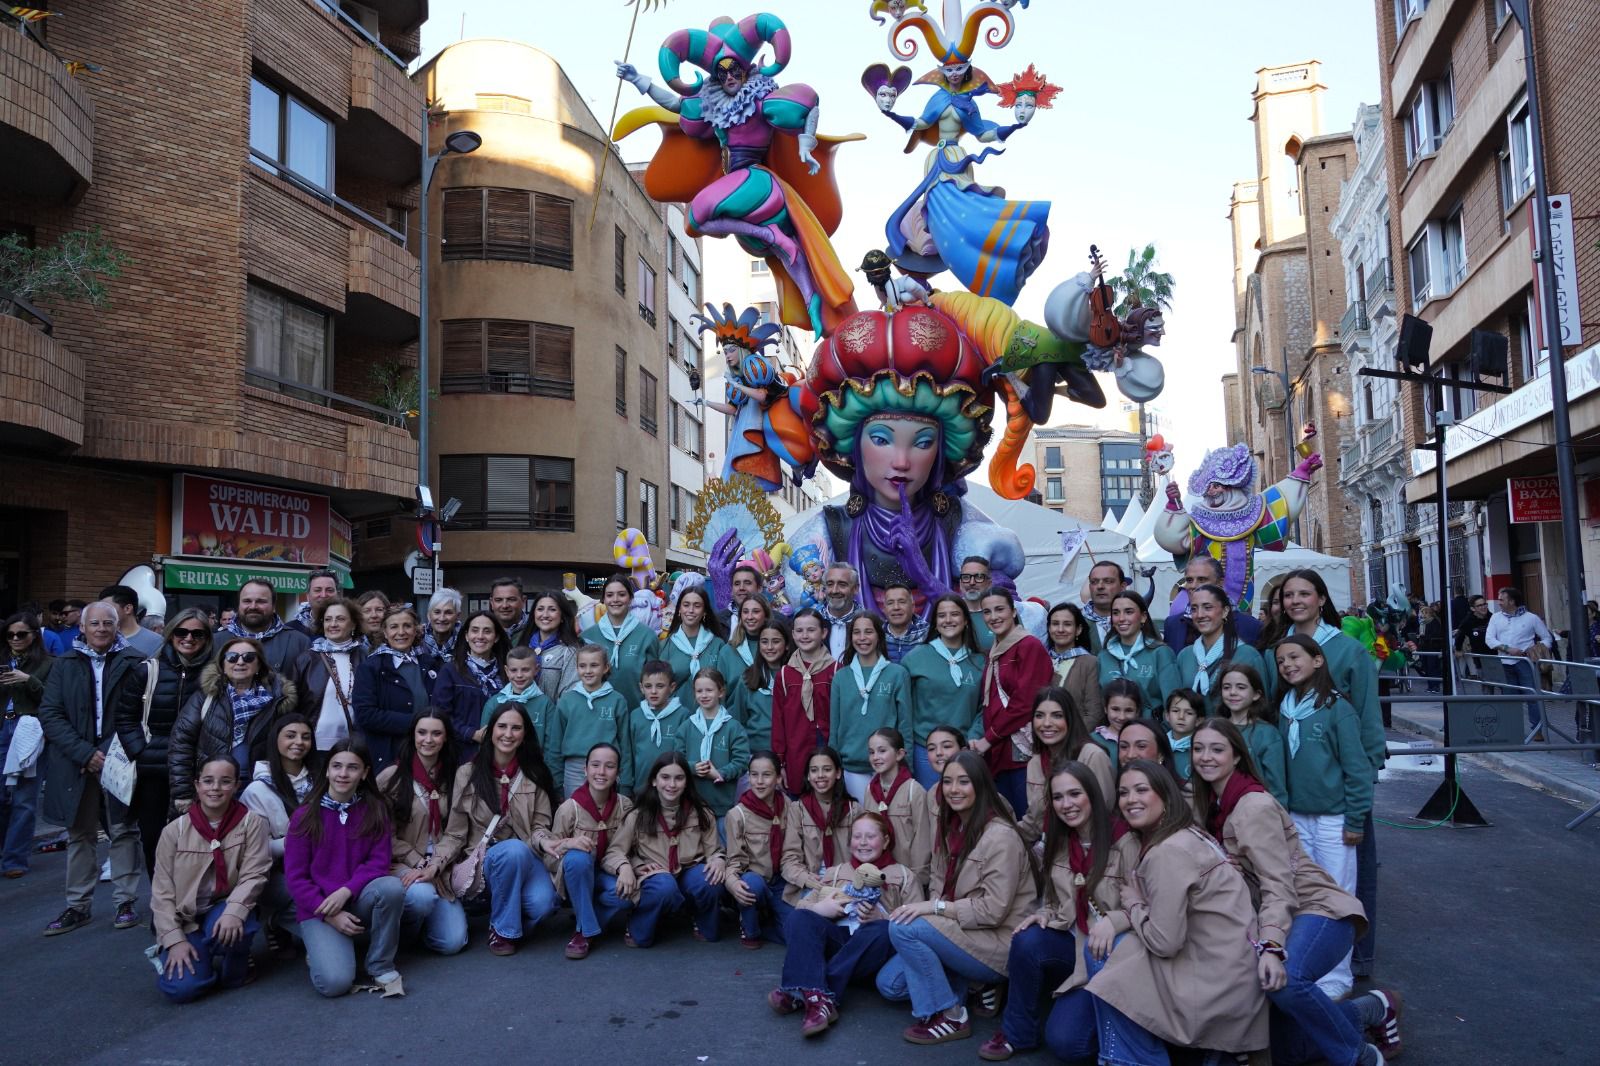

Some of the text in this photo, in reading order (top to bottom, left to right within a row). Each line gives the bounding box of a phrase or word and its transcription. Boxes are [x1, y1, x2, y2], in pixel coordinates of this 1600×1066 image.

[209, 483, 310, 512] SUPERMERCADO
[1520, 489, 1560, 500] BAZA
[209, 502, 311, 539] WALID
[179, 570, 230, 586] FRUTAS
[235, 574, 242, 586] Y
[879, 682, 892, 694] M
[1311, 722, 1323, 737] S
